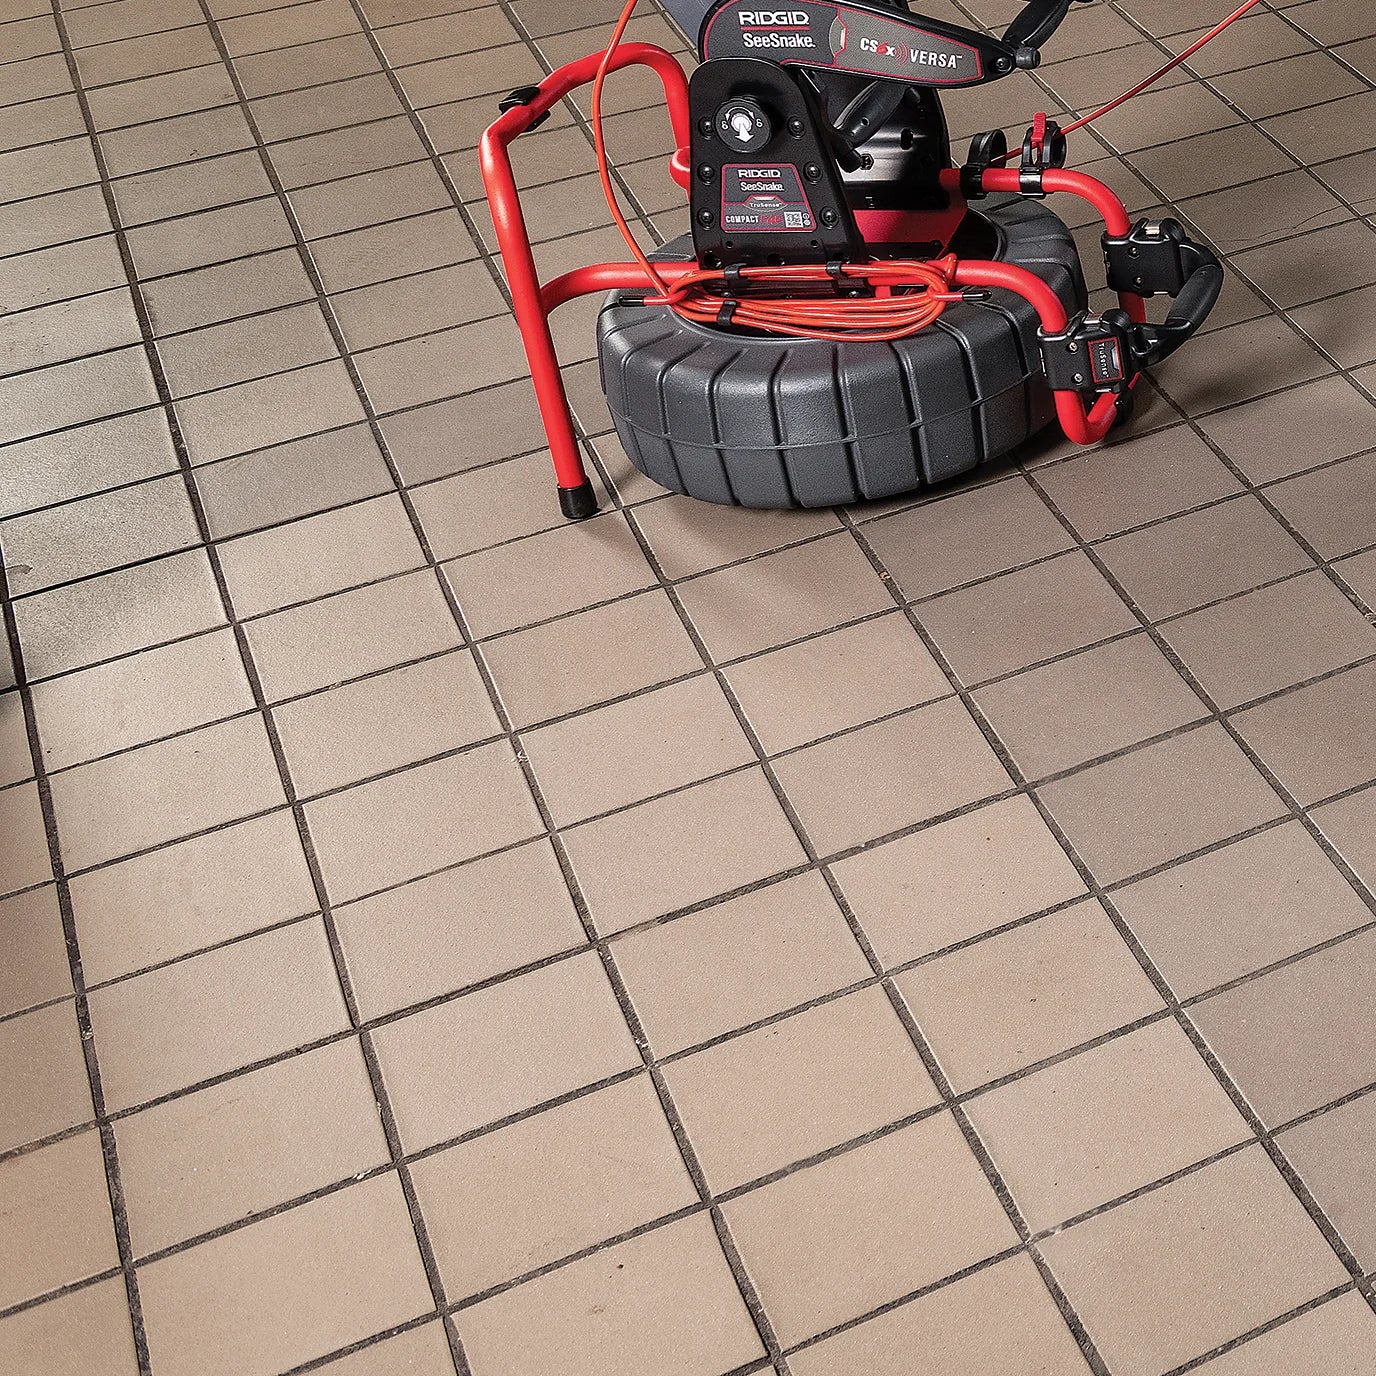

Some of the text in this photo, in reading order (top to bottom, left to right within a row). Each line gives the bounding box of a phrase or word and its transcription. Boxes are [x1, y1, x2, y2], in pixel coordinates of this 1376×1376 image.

[738, 11, 810, 26] RIDGID
[743, 33, 814, 49] SeeSnake
[738, 169, 781, 178] RIDGID
[740, 182, 784, 192] SeeSnake
[725, 215, 759, 223] COMPACT
